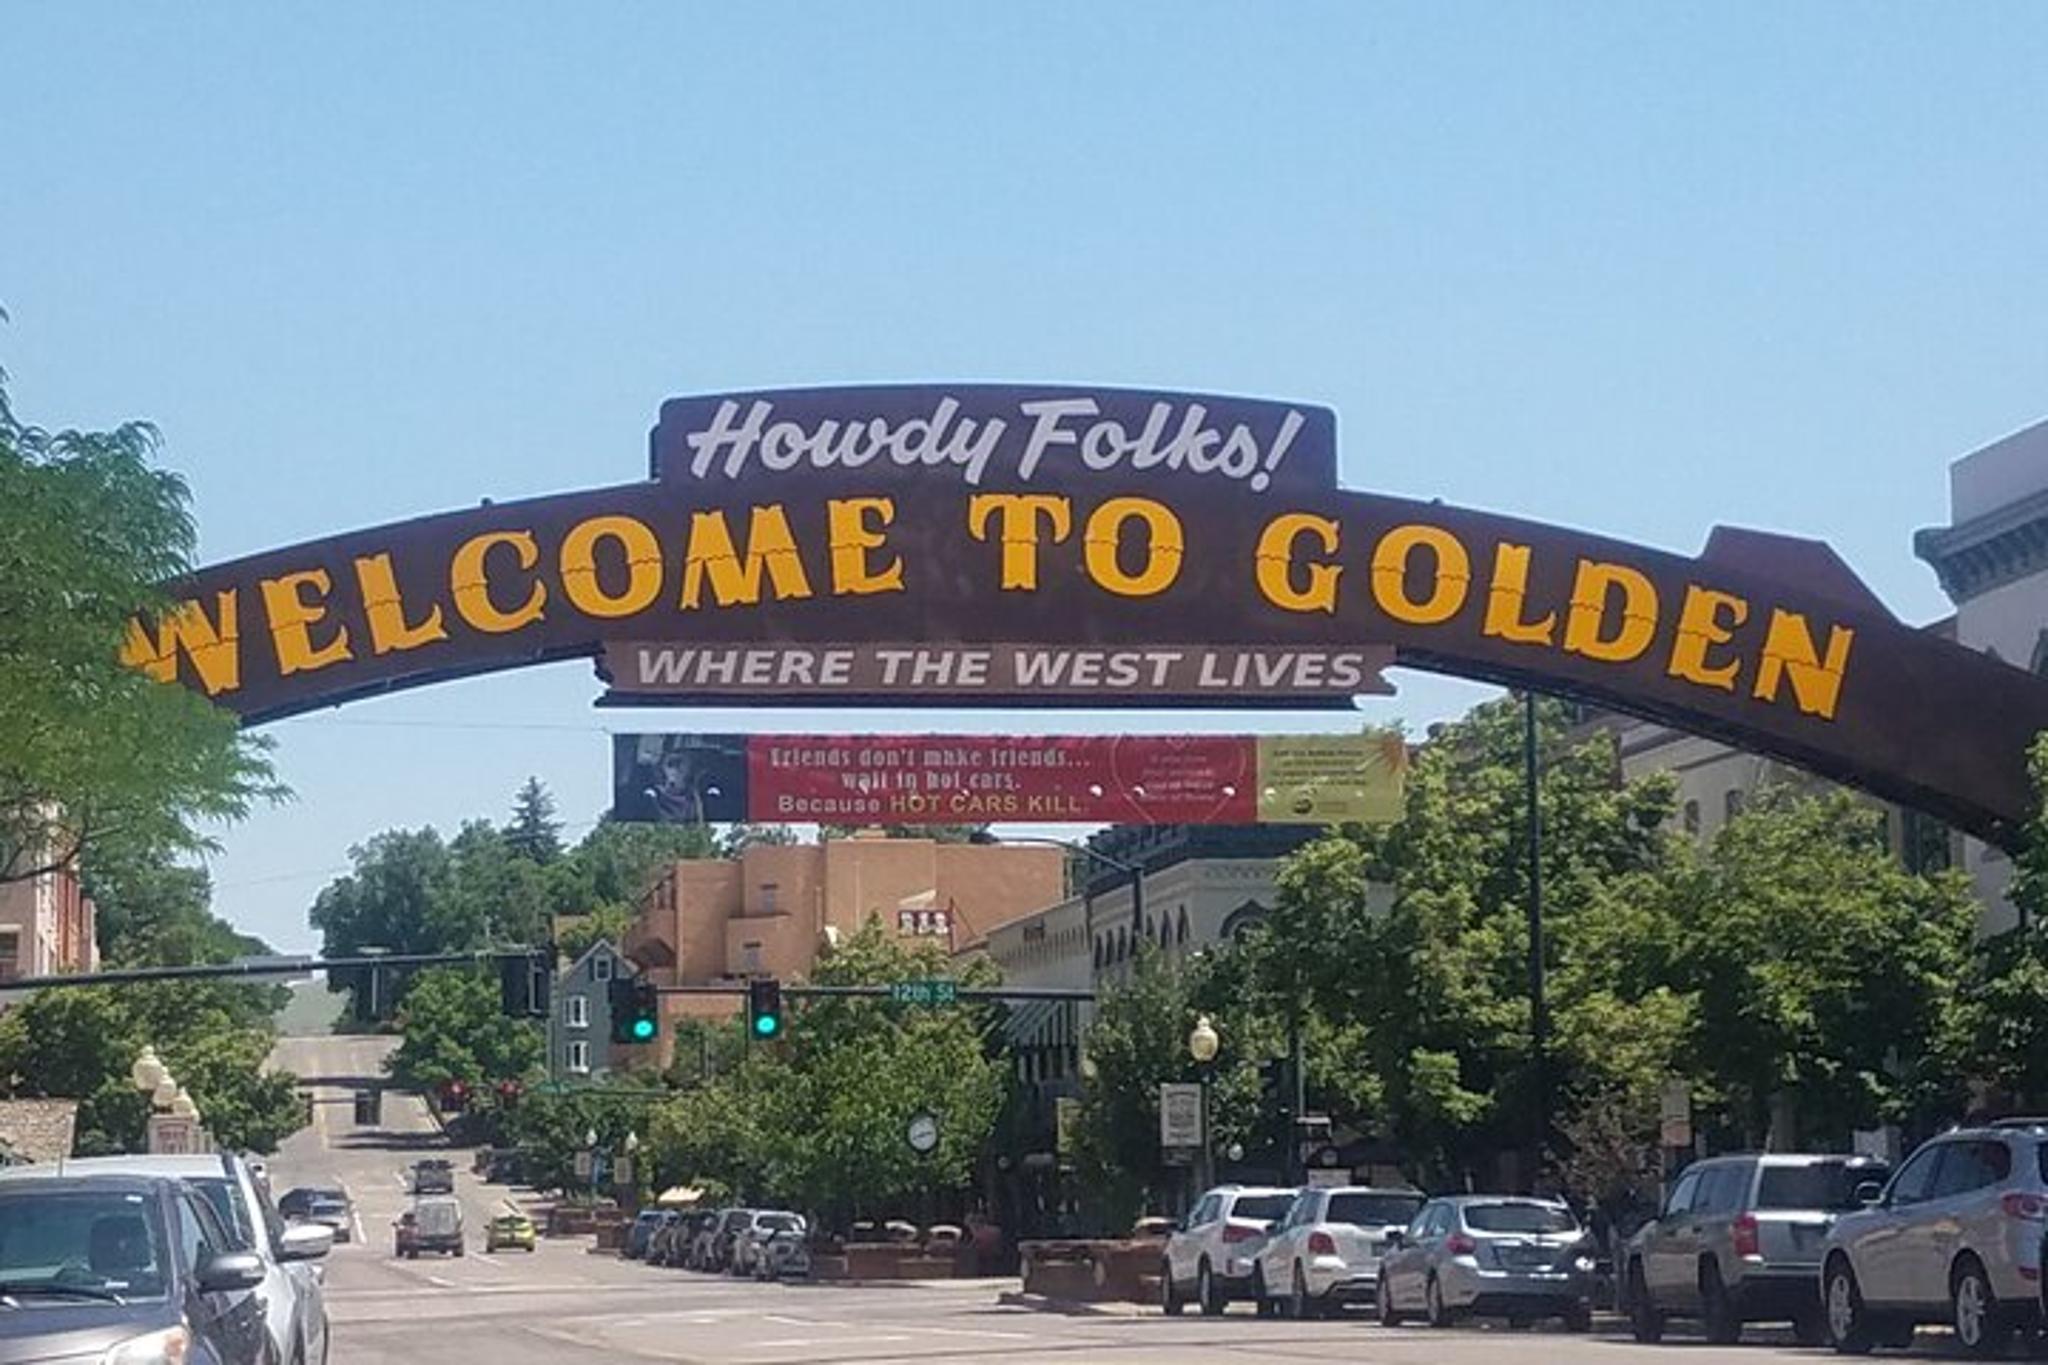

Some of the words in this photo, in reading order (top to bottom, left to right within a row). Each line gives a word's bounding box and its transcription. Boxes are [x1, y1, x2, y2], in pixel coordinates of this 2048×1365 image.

[687, 397, 1007, 485] Howdy
[1021, 398, 1305, 492] Folks!
[119, 497, 905, 696] WELCOME
[968, 493, 1184, 596] TO
[1255, 513, 1855, 720] GOLDEN
[638, 650, 854, 684] WHERE
[876, 651, 991, 685] THE
[1013, 652, 1183, 687] WEST
[1198, 653, 1364, 687] LIVES
[859, 748, 915, 766] don't
[923, 748, 983, 767] make
[897, 771, 917, 790] in
[926, 771, 960, 790] hot
[778, 795, 881, 813] Because
[891, 795, 941, 813] HOT
[950, 795, 1019, 813] CARS
